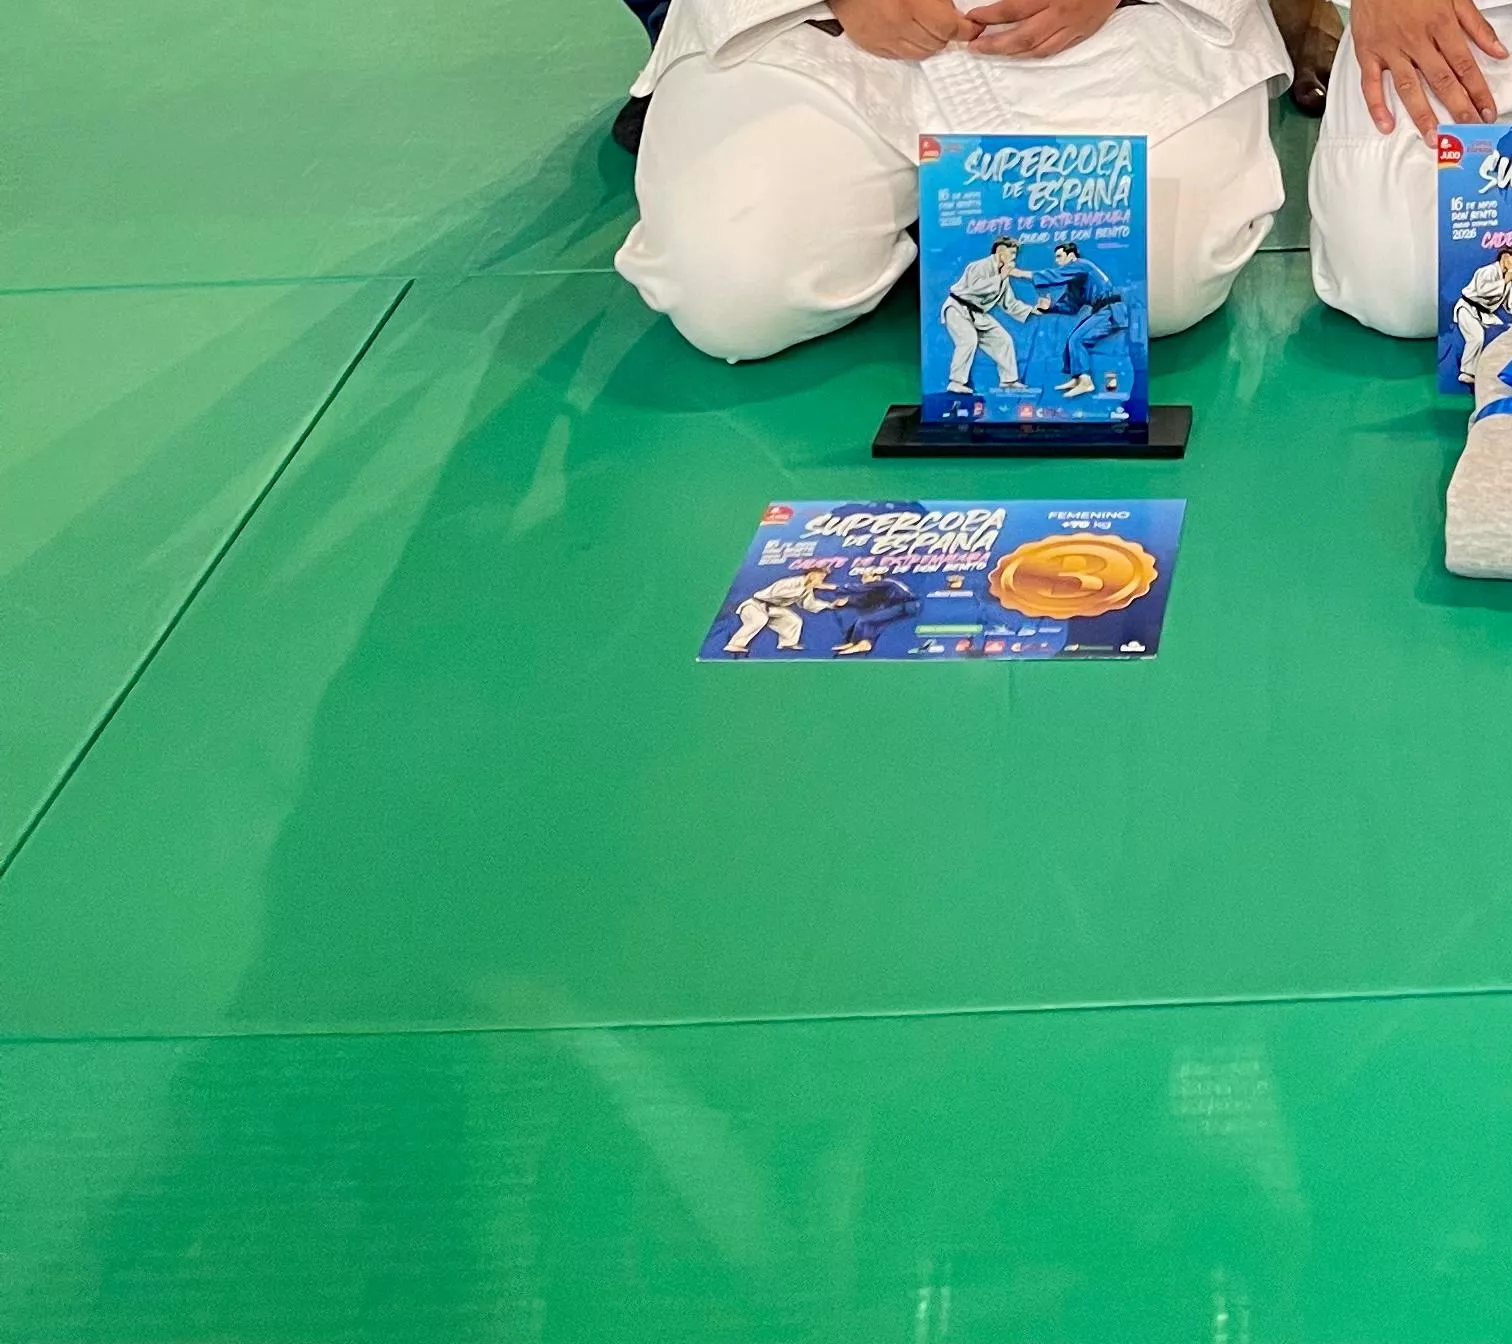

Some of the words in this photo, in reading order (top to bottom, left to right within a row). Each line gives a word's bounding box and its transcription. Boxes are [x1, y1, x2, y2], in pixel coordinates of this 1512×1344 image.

[963, 140, 1133, 185] SUPERCOPA
[1439, 151, 1462, 161] JUDO
[1003, 181, 1025, 200] DE
[1451, 196, 1463, 211] 16
[1047, 511, 1131, 520] FEMENINO
